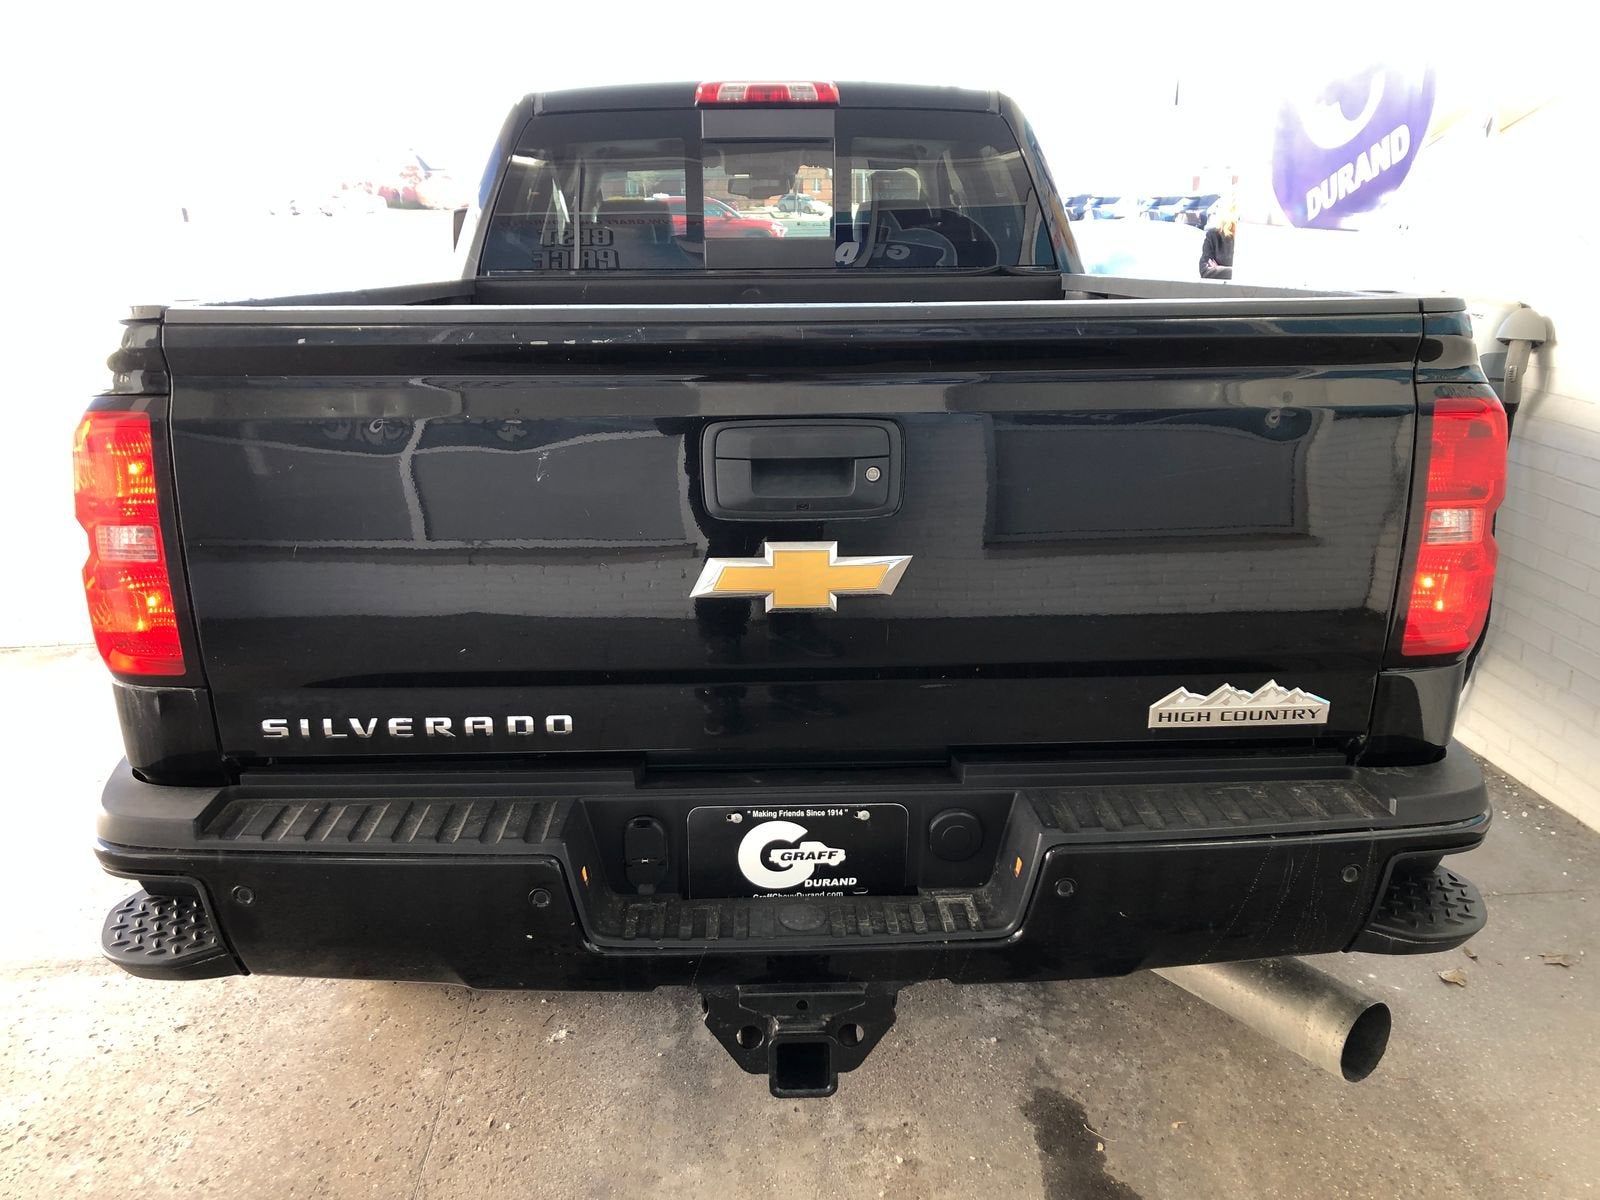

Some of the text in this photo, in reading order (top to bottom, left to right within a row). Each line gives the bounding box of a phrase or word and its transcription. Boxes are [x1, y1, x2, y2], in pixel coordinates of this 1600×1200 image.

[1306, 124, 1411, 222] DURAND
[1158, 708, 1321, 723] HIGH COUNTRY
[261, 714, 573, 738] SILVERADO
[752, 810, 777, 819] Making
[779, 809, 805, 818] Friends
[806, 809, 826, 817] Since
[827, 808, 843, 817] 1914
[780, 850, 839, 861] GRAFF
[804, 877, 857, 888] DURAND
